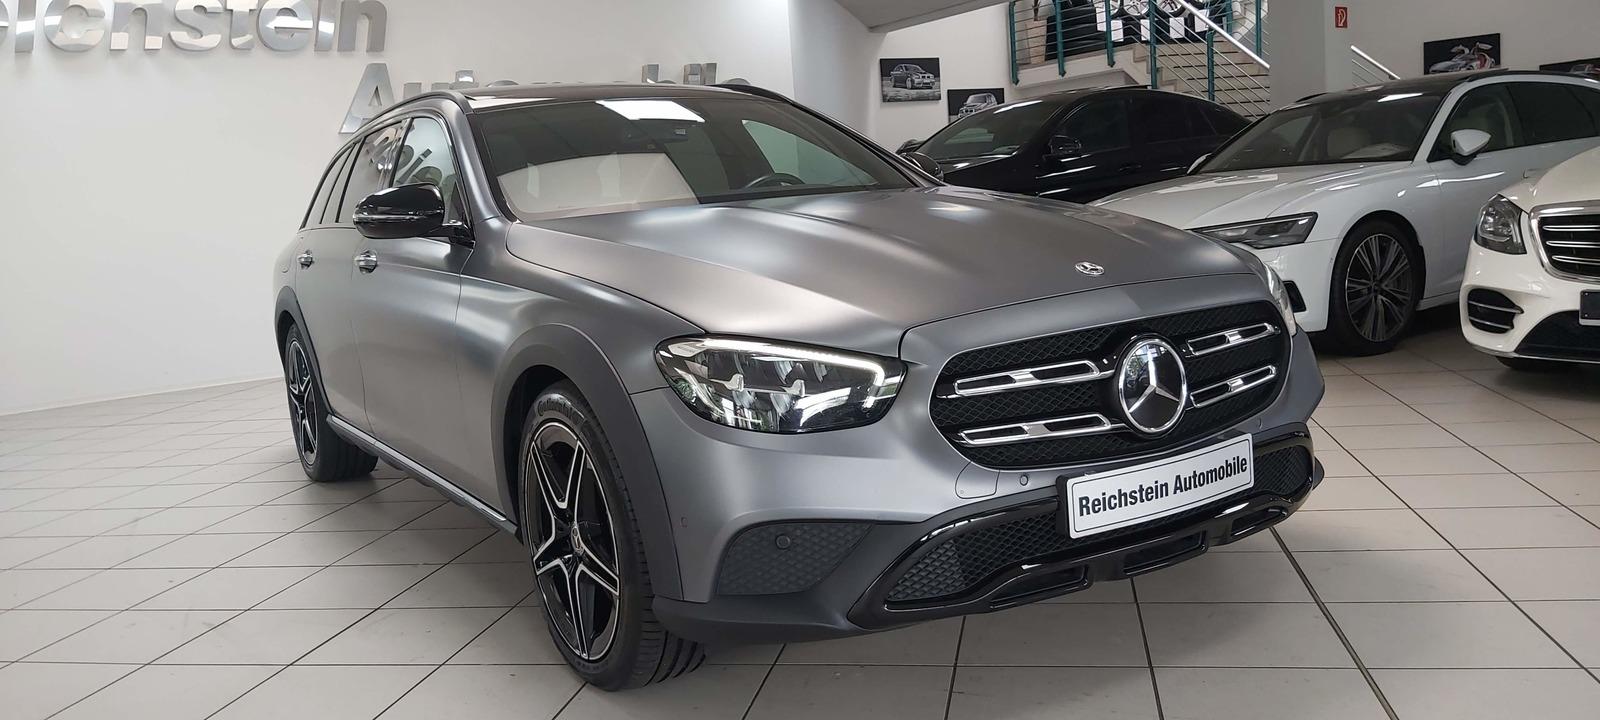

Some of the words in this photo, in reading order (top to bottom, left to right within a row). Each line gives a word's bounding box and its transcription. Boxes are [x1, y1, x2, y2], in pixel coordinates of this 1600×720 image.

[0, 0, 388, 52] ichstein
[1078, 480, 1169, 517] Reichstein
[1173, 455, 1248, 495] Automobile
